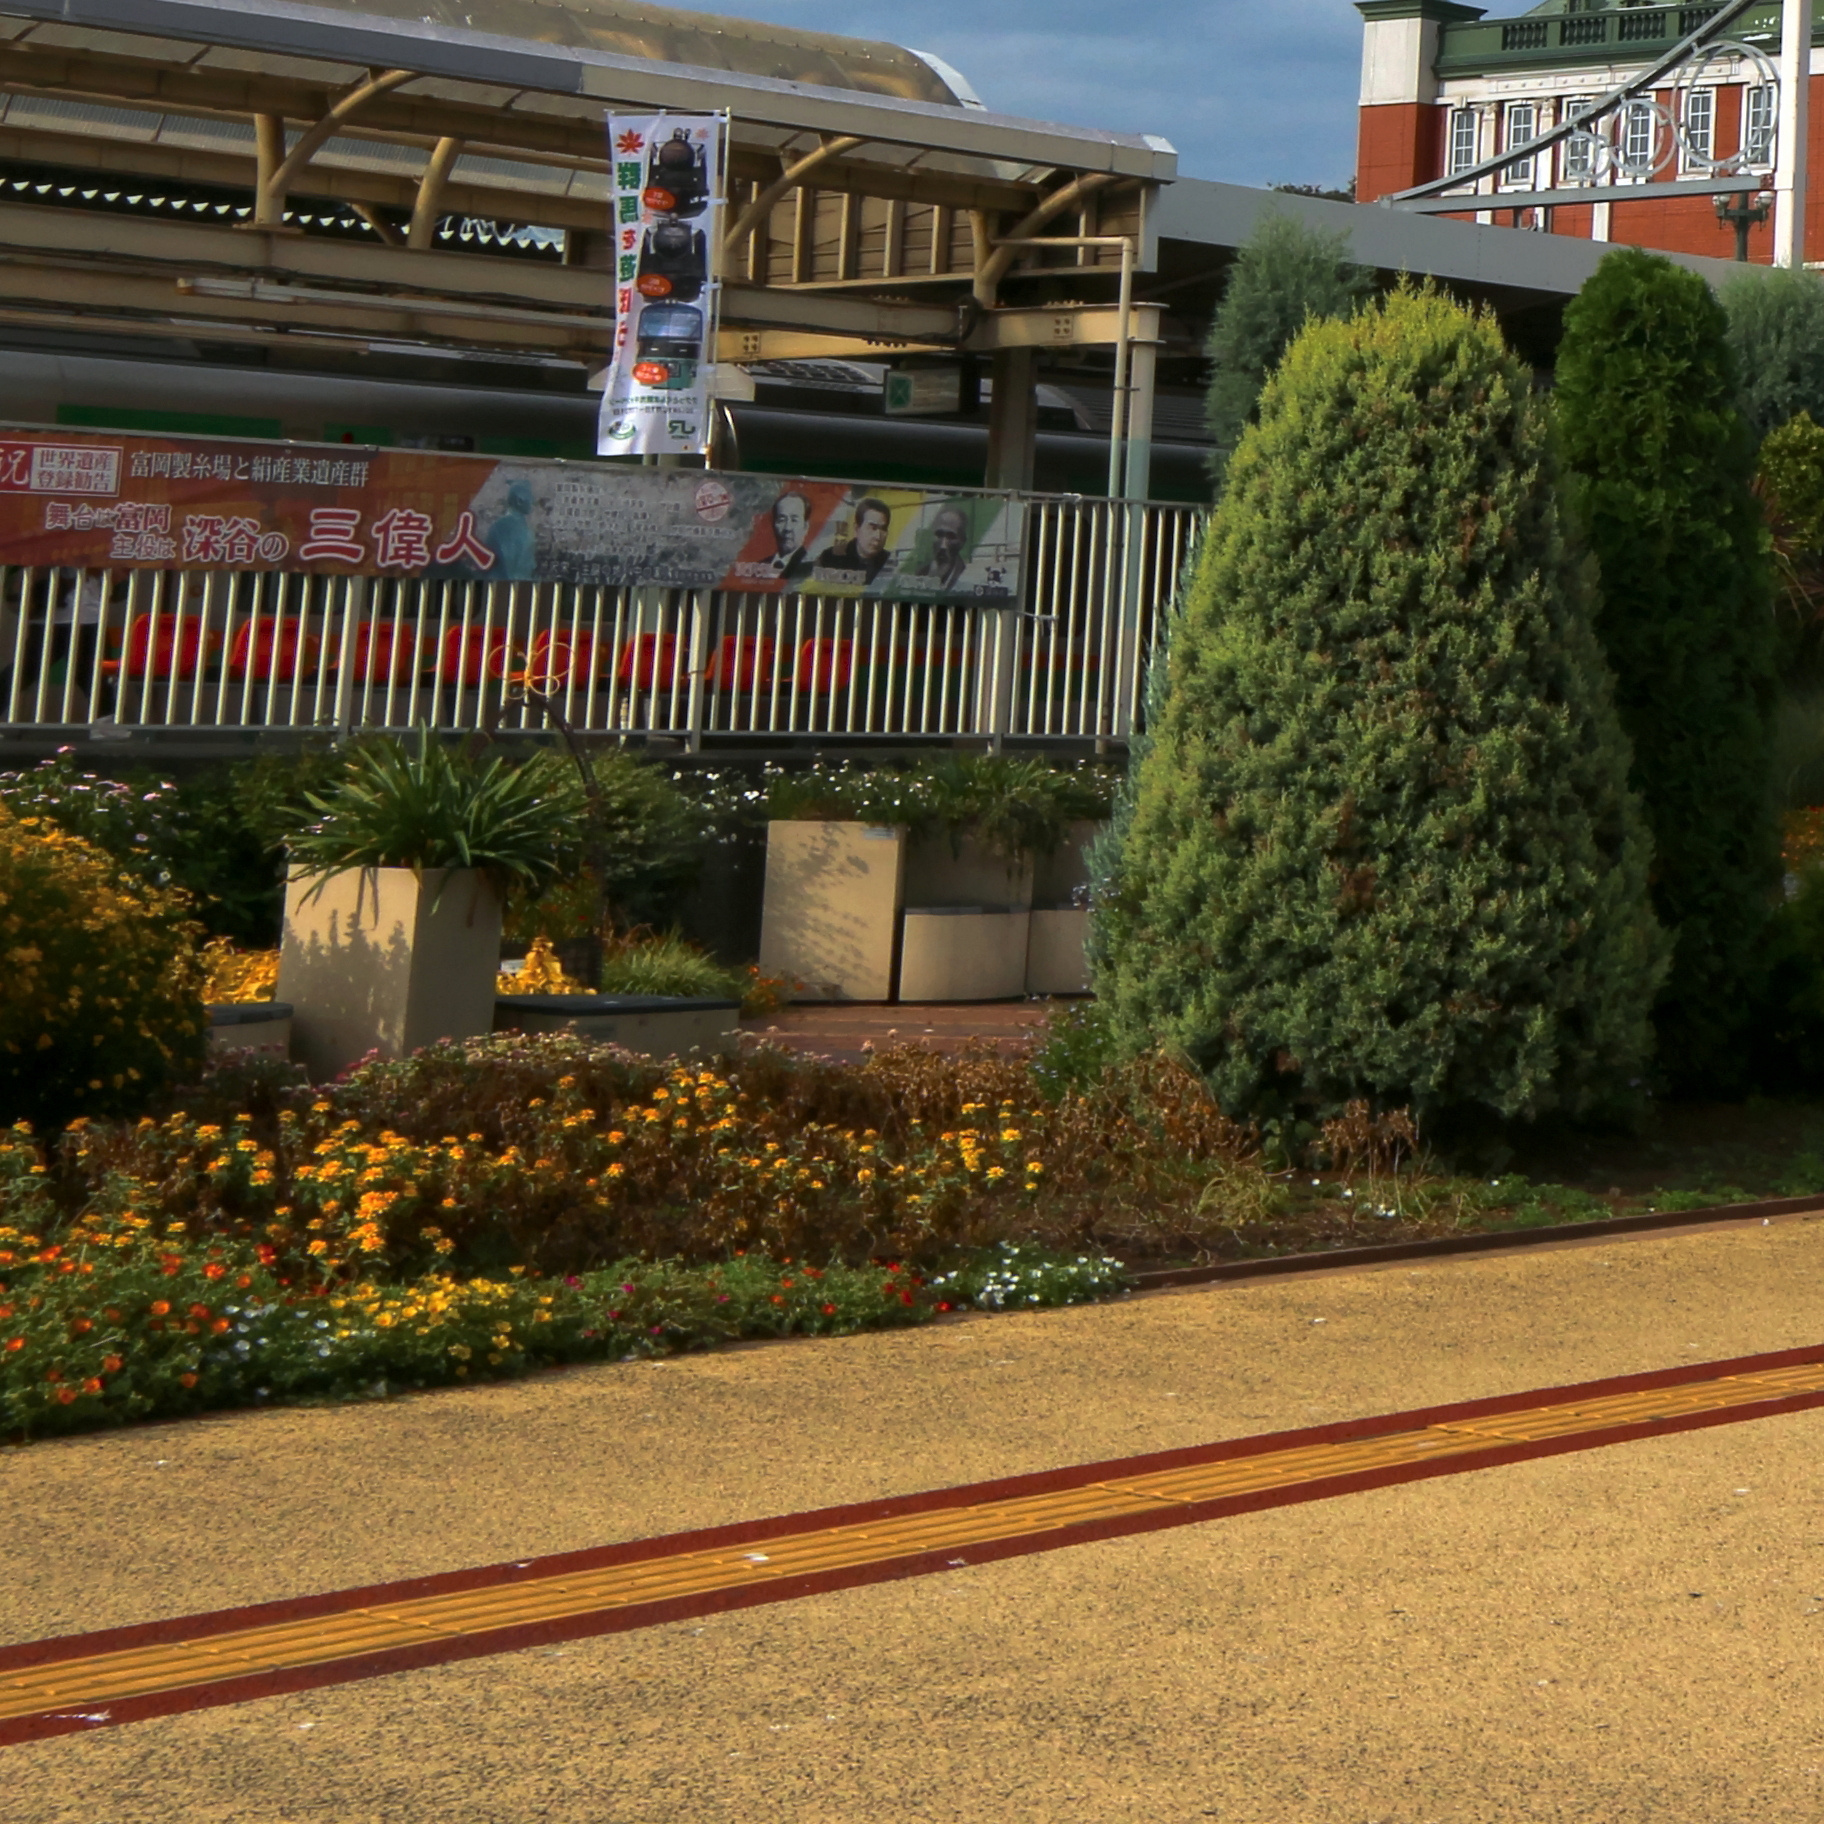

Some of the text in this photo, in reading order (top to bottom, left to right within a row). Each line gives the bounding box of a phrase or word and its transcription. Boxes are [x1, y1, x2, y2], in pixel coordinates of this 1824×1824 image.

[39, 449, 113, 472] 世界遺産
[130, 450, 370, 487] 富岡製糸場と絹産業遺産群
[36, 470, 112, 491] 登録勧告
[45, 501, 171, 533] 舞台は富岡
[110, 534, 177, 560] 主役は
